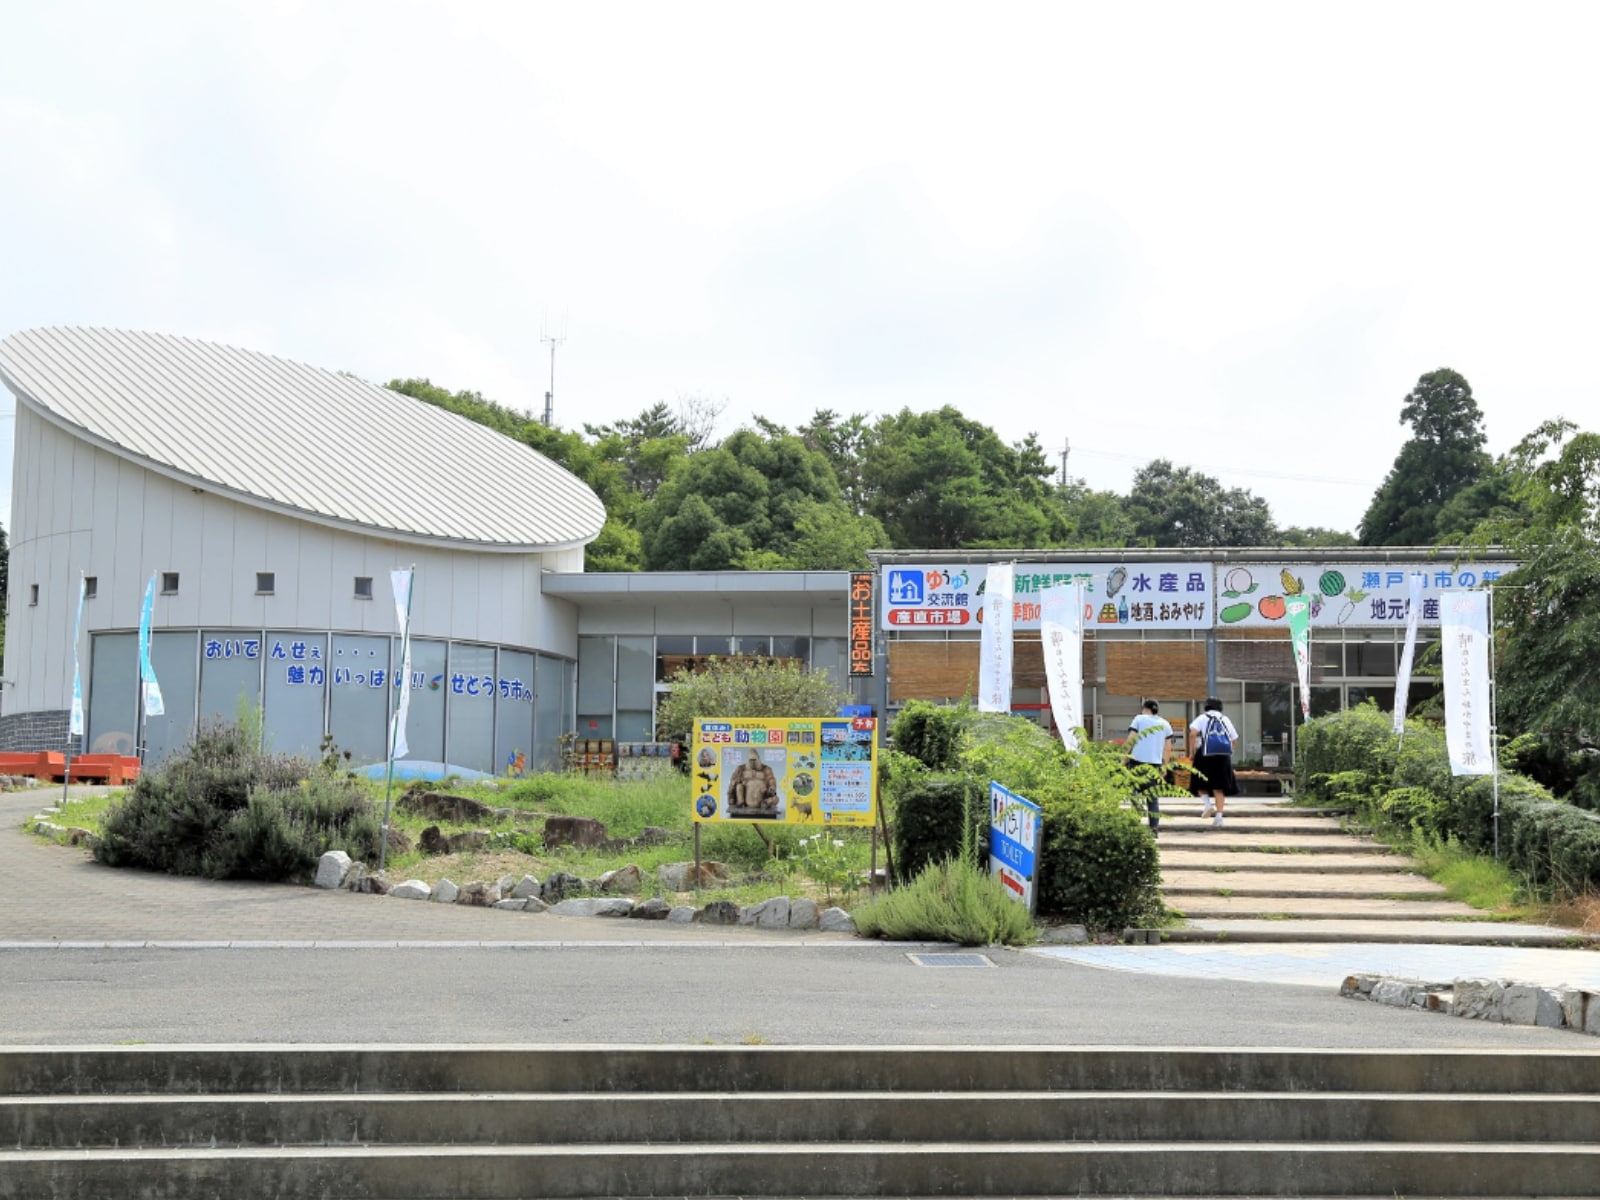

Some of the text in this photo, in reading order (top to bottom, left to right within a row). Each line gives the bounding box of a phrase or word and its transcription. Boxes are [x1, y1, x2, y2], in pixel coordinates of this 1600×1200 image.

[926, 569, 969, 590] ゆうゆう
[1132, 572, 1205, 592] 水産品
[928, 593, 969, 606] 交流館
[896, 610, 962, 624] 産直市場
